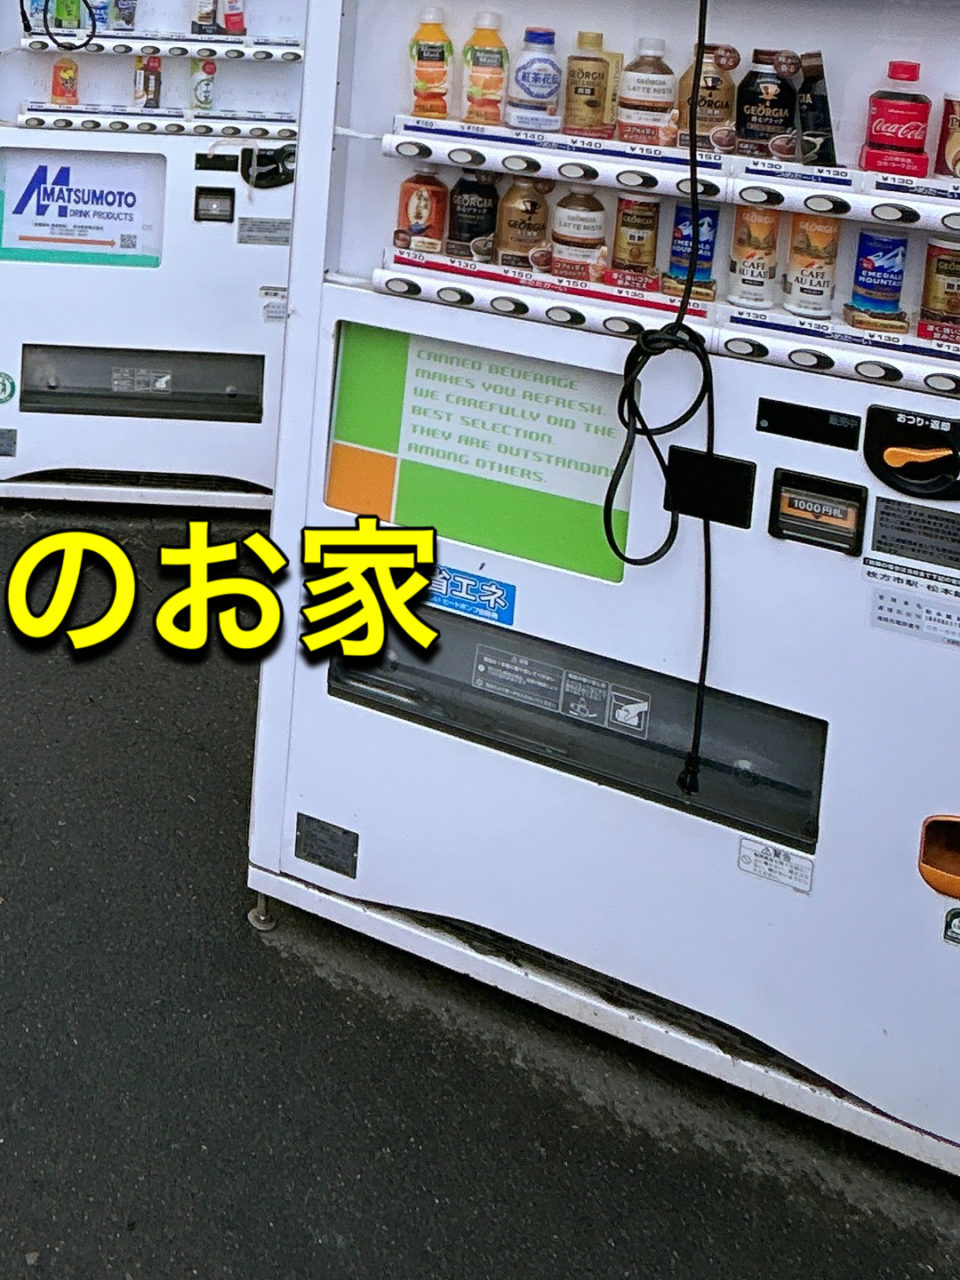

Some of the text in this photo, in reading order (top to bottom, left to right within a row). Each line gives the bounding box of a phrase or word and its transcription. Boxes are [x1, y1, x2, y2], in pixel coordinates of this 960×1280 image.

[521, 71, 561, 85] 紅茶花伝
[743, 104, 790, 118] GEORGIA
[42, 186, 137, 208] MATSUMOTO
[69, 208, 134, 222] DRINK PRODUCTS
[416, 348, 578, 391] CANNED BEVERAGE
[414, 368, 607, 417] MAKES YOU REFRESH.
[411, 405, 555, 445] BEST SELECTION.
[413, 386, 618, 439] WE CAREFULLY DID THE
[410, 423, 452, 441] THEY
[457, 433, 491, 450] ARE
[407, 442, 548, 484] AMONG OTHERS.
[793, 499, 844, 518] 1000円札
